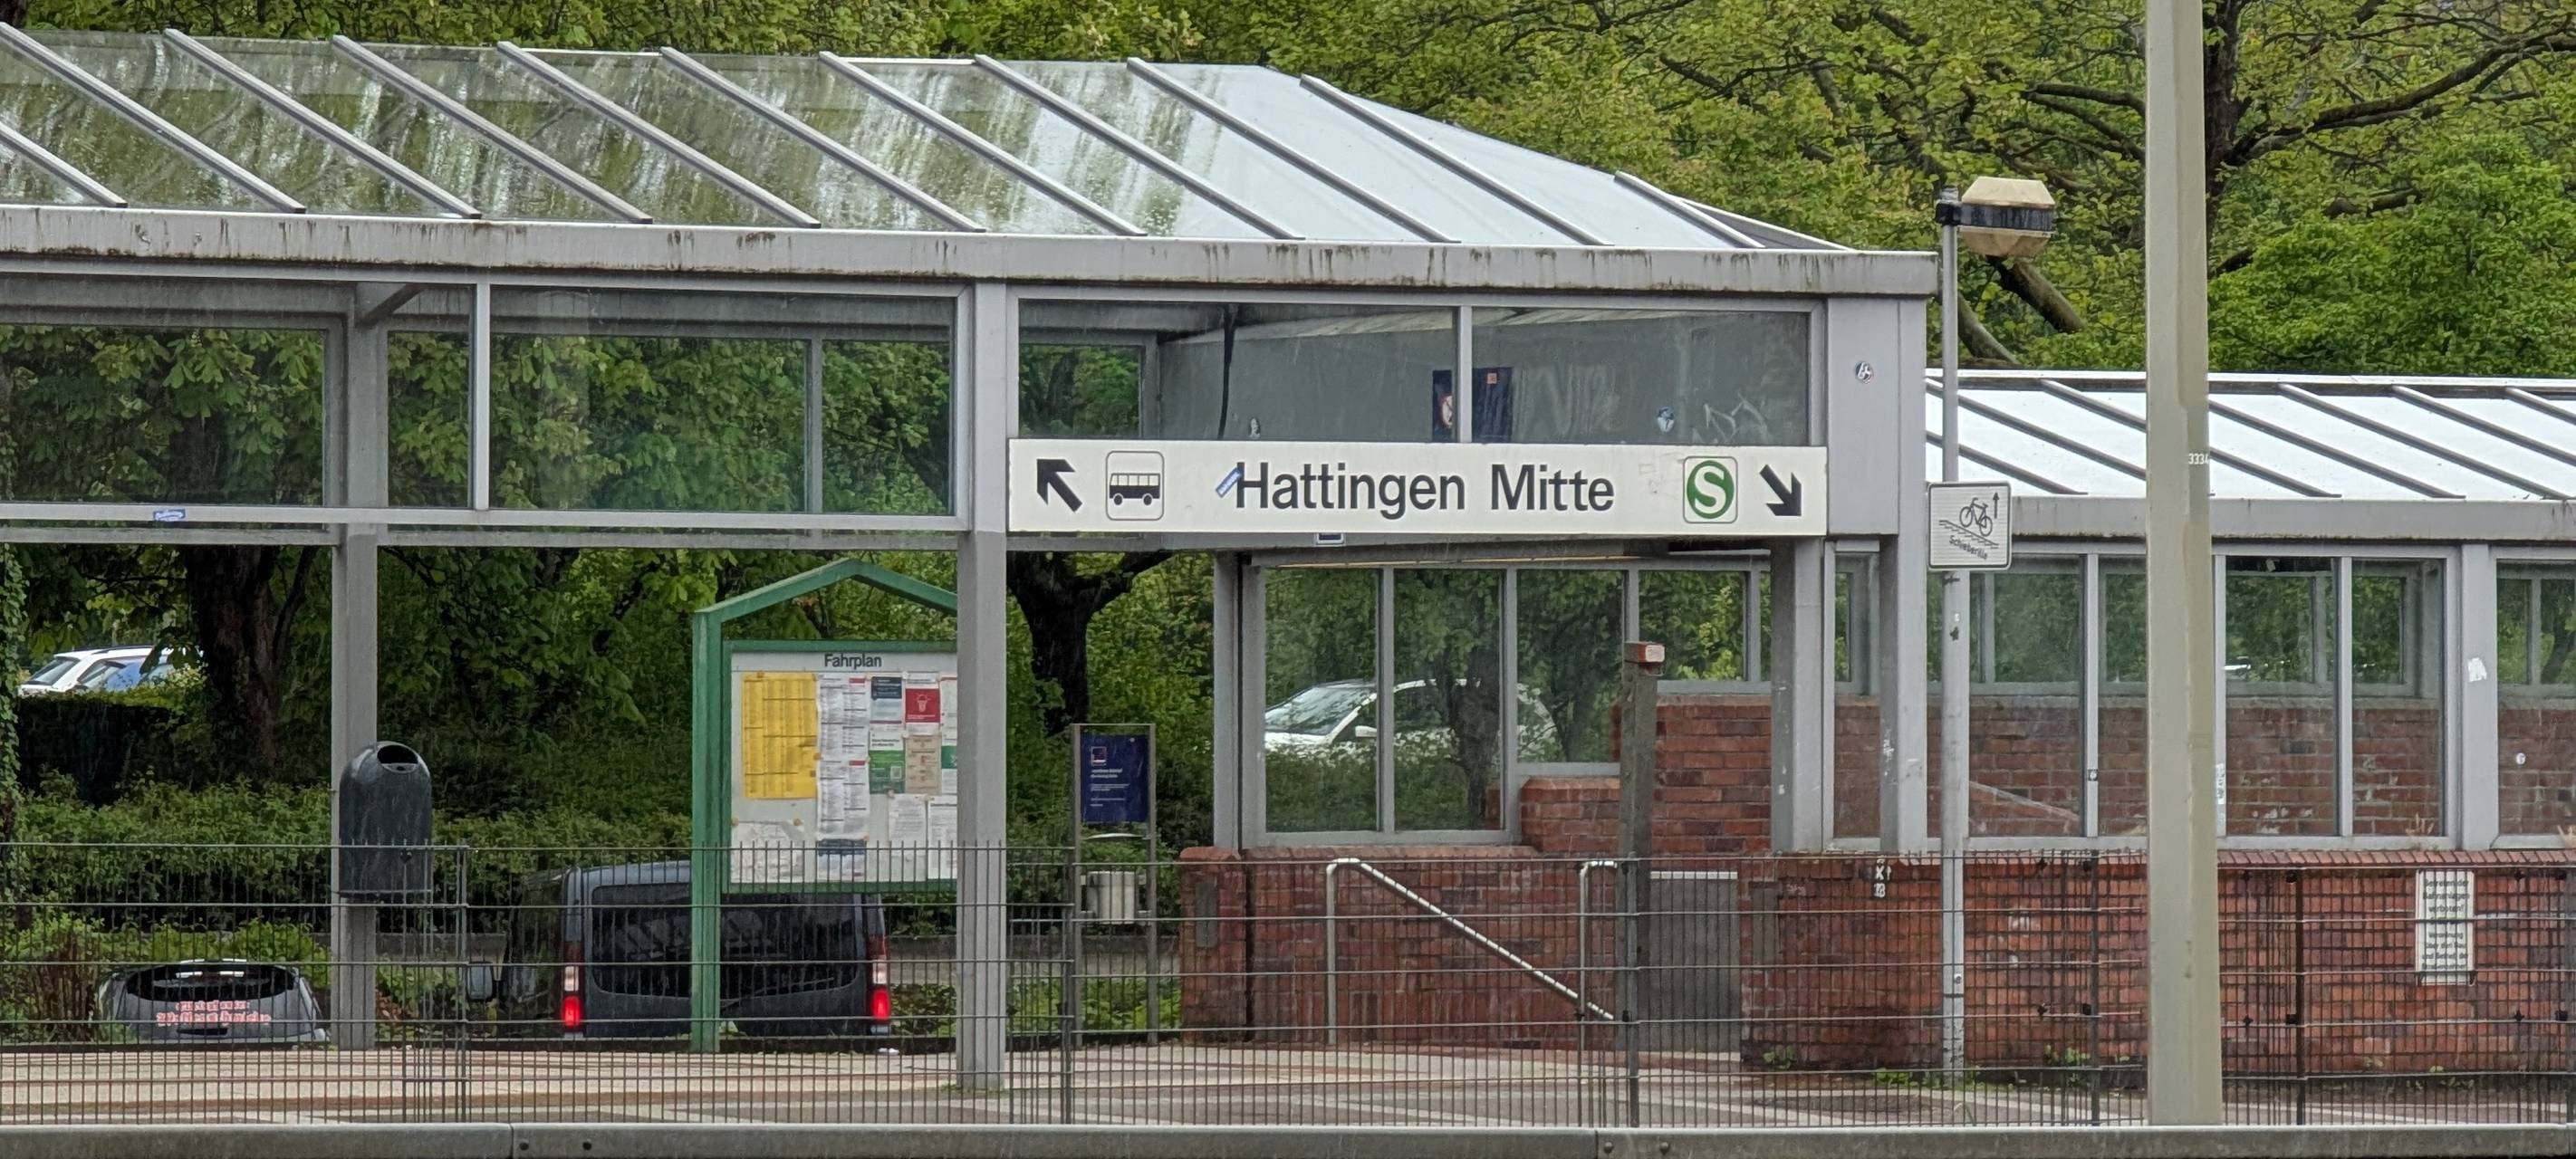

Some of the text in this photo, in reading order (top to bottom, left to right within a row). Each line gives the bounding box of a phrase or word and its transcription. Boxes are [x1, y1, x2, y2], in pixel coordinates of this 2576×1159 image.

[1235, 462, 1465, 520] Hattingen
[1491, 464, 1615, 511] Mitte
[824, 653, 882, 670] Fahrplan
